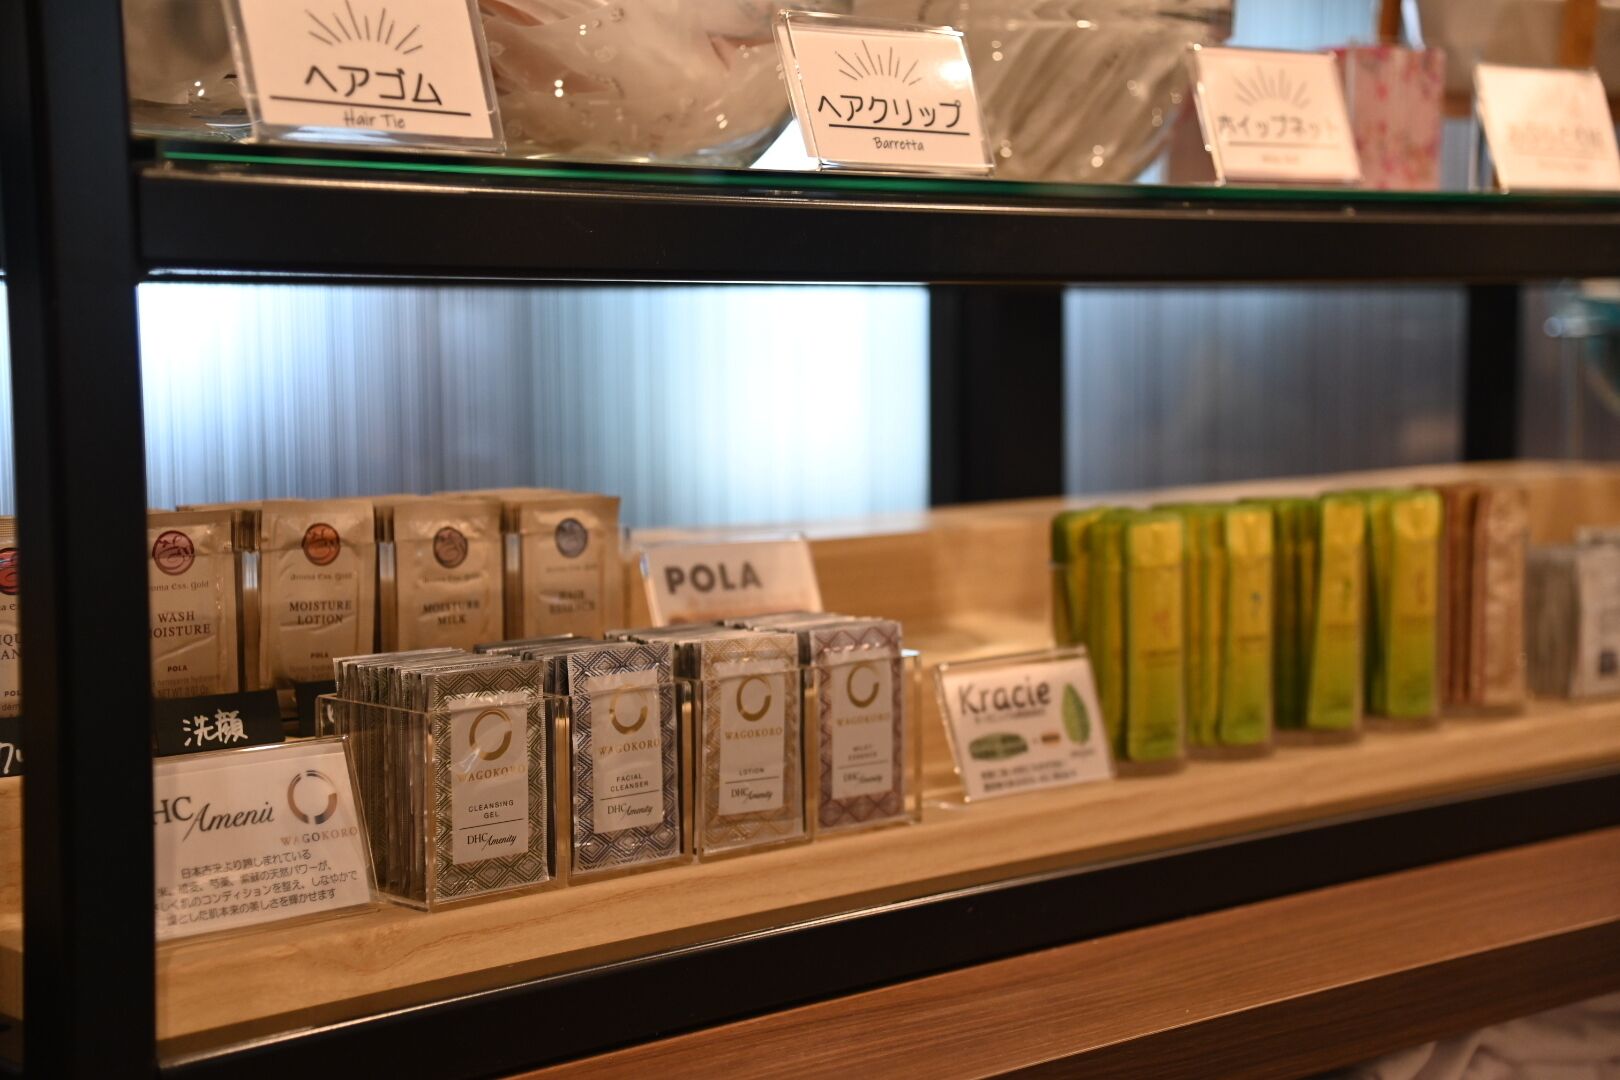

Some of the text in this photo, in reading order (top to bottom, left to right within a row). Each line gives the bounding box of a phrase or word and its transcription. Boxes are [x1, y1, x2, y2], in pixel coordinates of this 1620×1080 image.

[305, 65, 442, 105] ヘアゴム
[817, 95, 962, 128] ヘアクリップ
[344, 110, 405, 128] Hair Tie
[872, 136, 925, 151] Barretta
[664, 561, 763, 595] POLA
[289, 600, 352, 612] MOISTURE
[158, 611, 195, 623] WASH
[297, 613, 343, 625] LOTION
[149, 624, 211, 639] OISTURE
[167, 664, 188, 672] POLA
[957, 675, 1052, 715] Kracie
[183, 709, 248, 746] 洗顔
[725, 727, 783, 739] WAGOKORO
[457, 765, 527, 783] WAGOKOO
[616, 773, 642, 782] FACIAL
[610, 781, 648, 792] CLEANSER
[468, 800, 514, 813] CLEANSING
[607, 803, 626, 814] DHC
[483, 811, 499, 819] GEL
[467, 832, 488, 844] DHC
